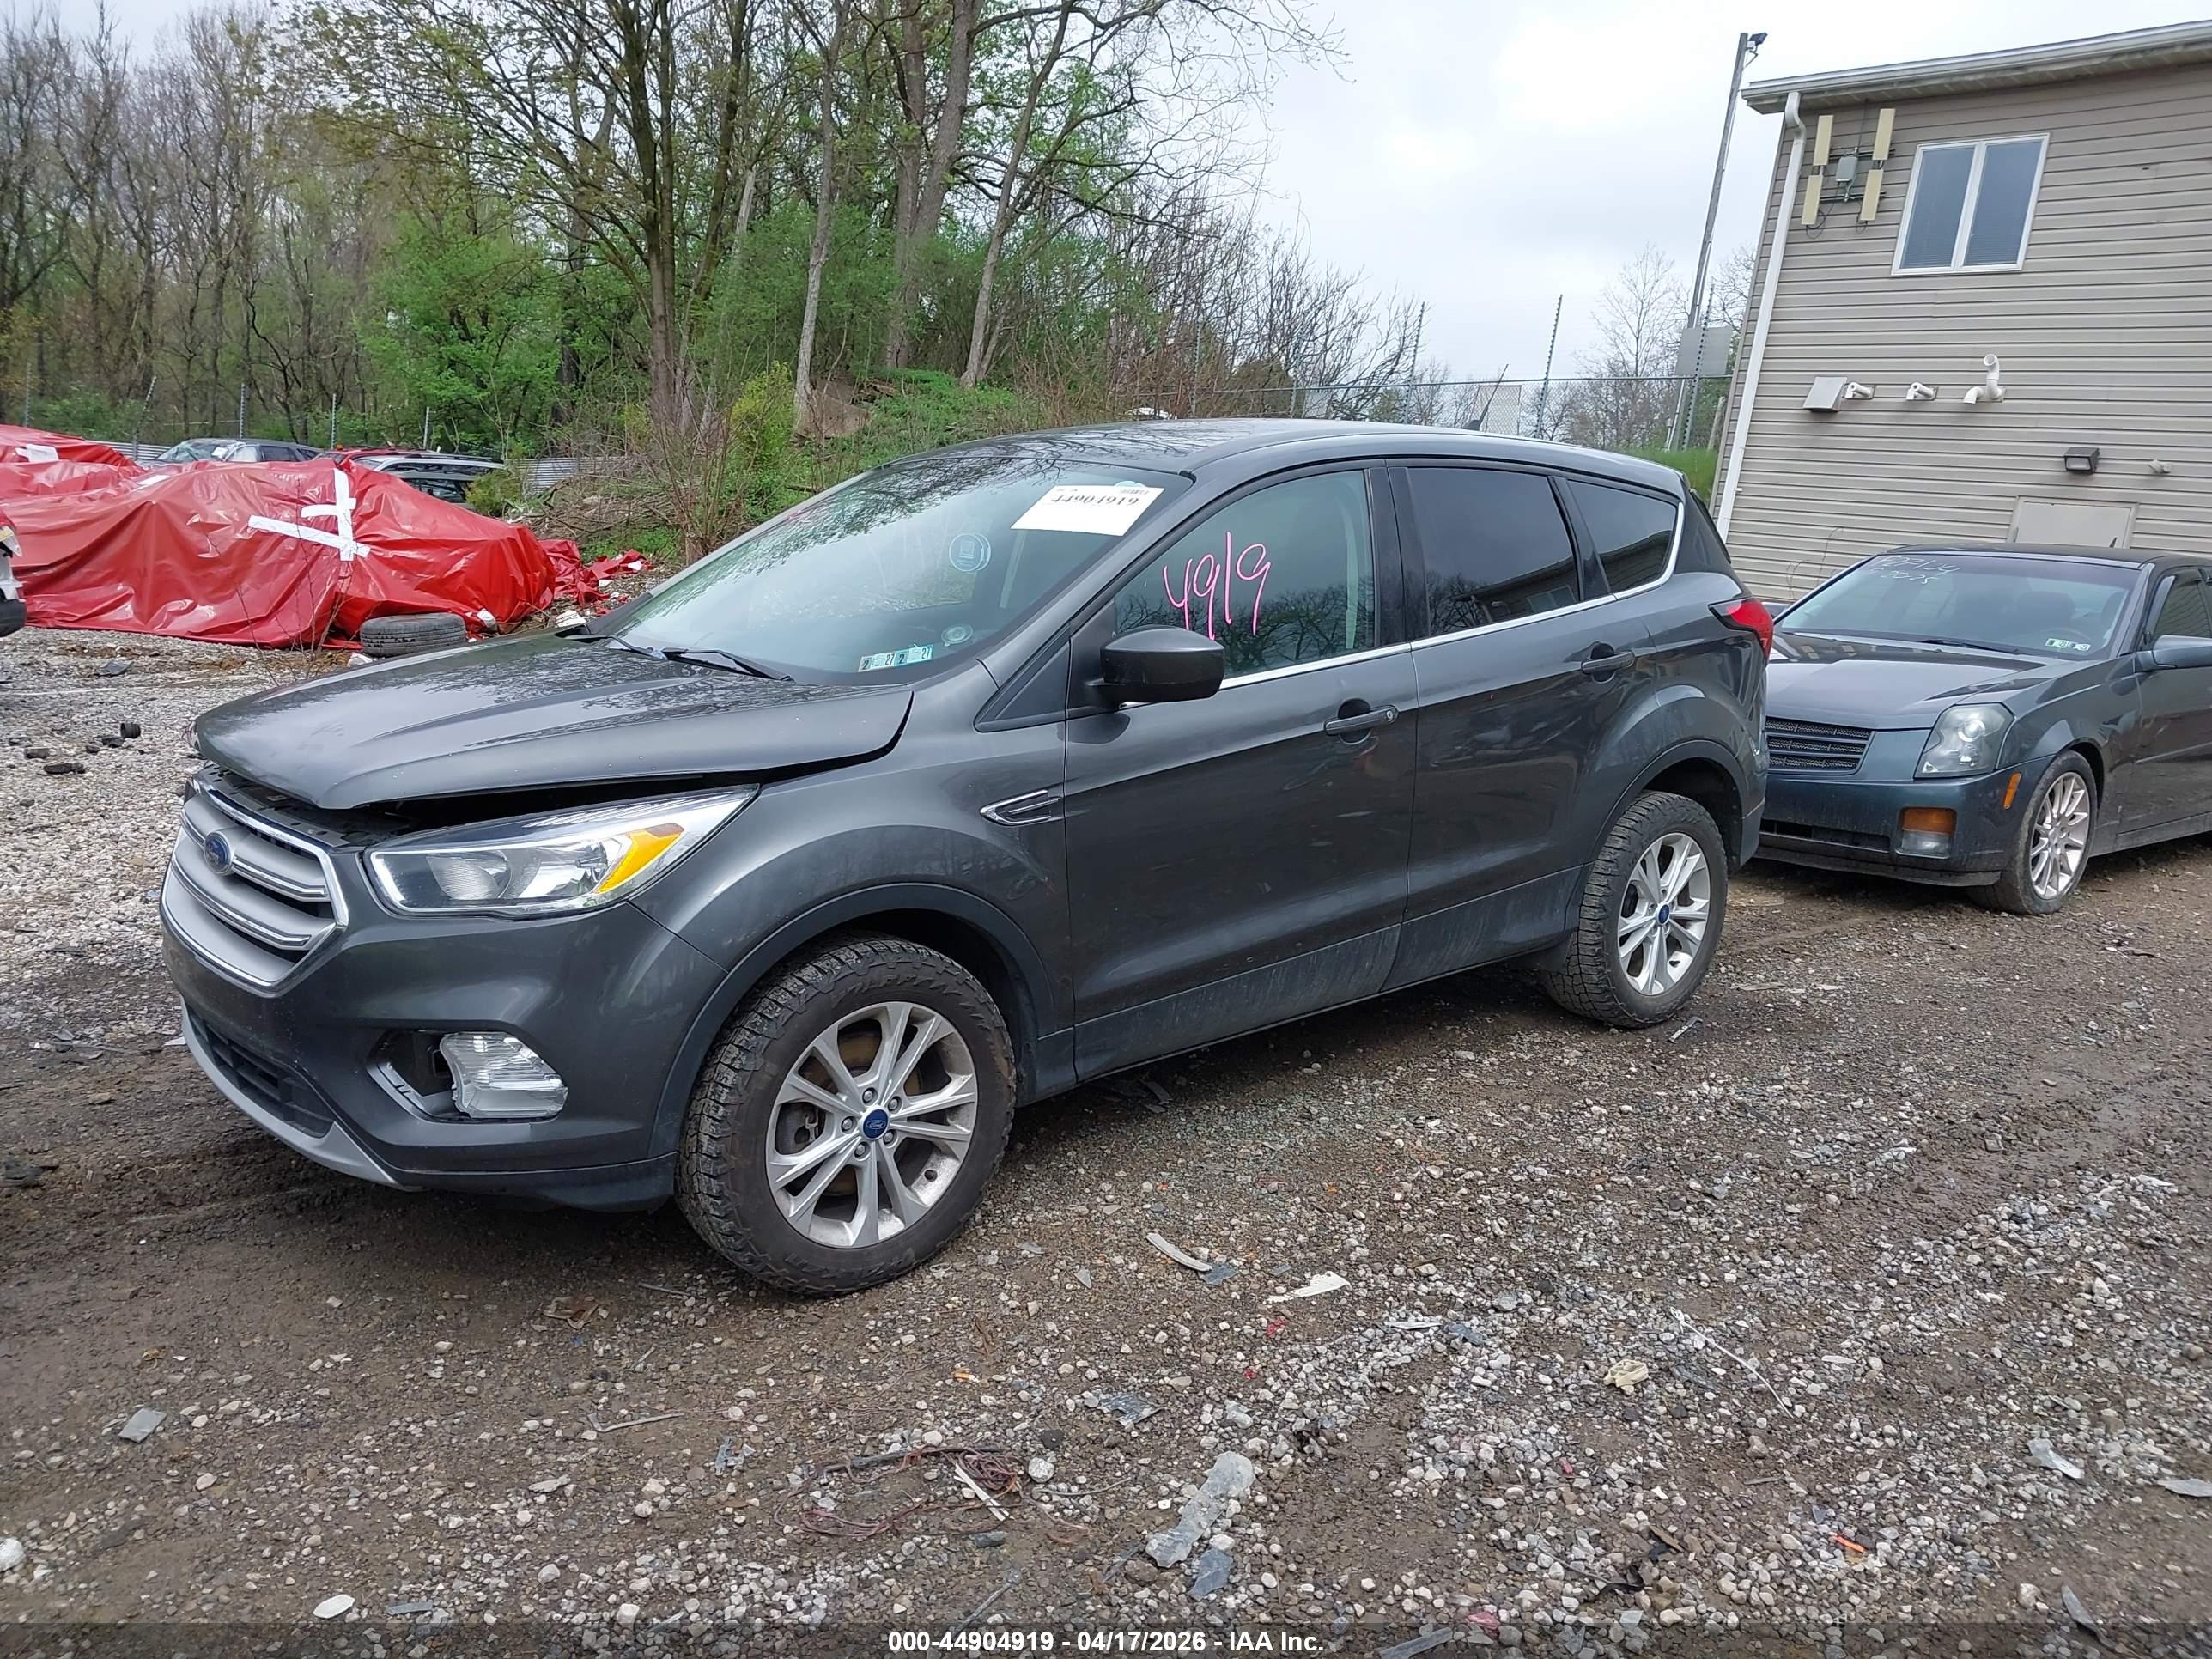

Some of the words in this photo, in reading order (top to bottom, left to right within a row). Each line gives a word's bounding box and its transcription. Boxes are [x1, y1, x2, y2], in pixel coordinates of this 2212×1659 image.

[1051, 495, 1140, 507] 44904919
[1163, 531, 1271, 641] 4919
[921, 647, 931, 659] 27
[862, 659, 870, 671] 2
[884, 653, 895, 665] 27
